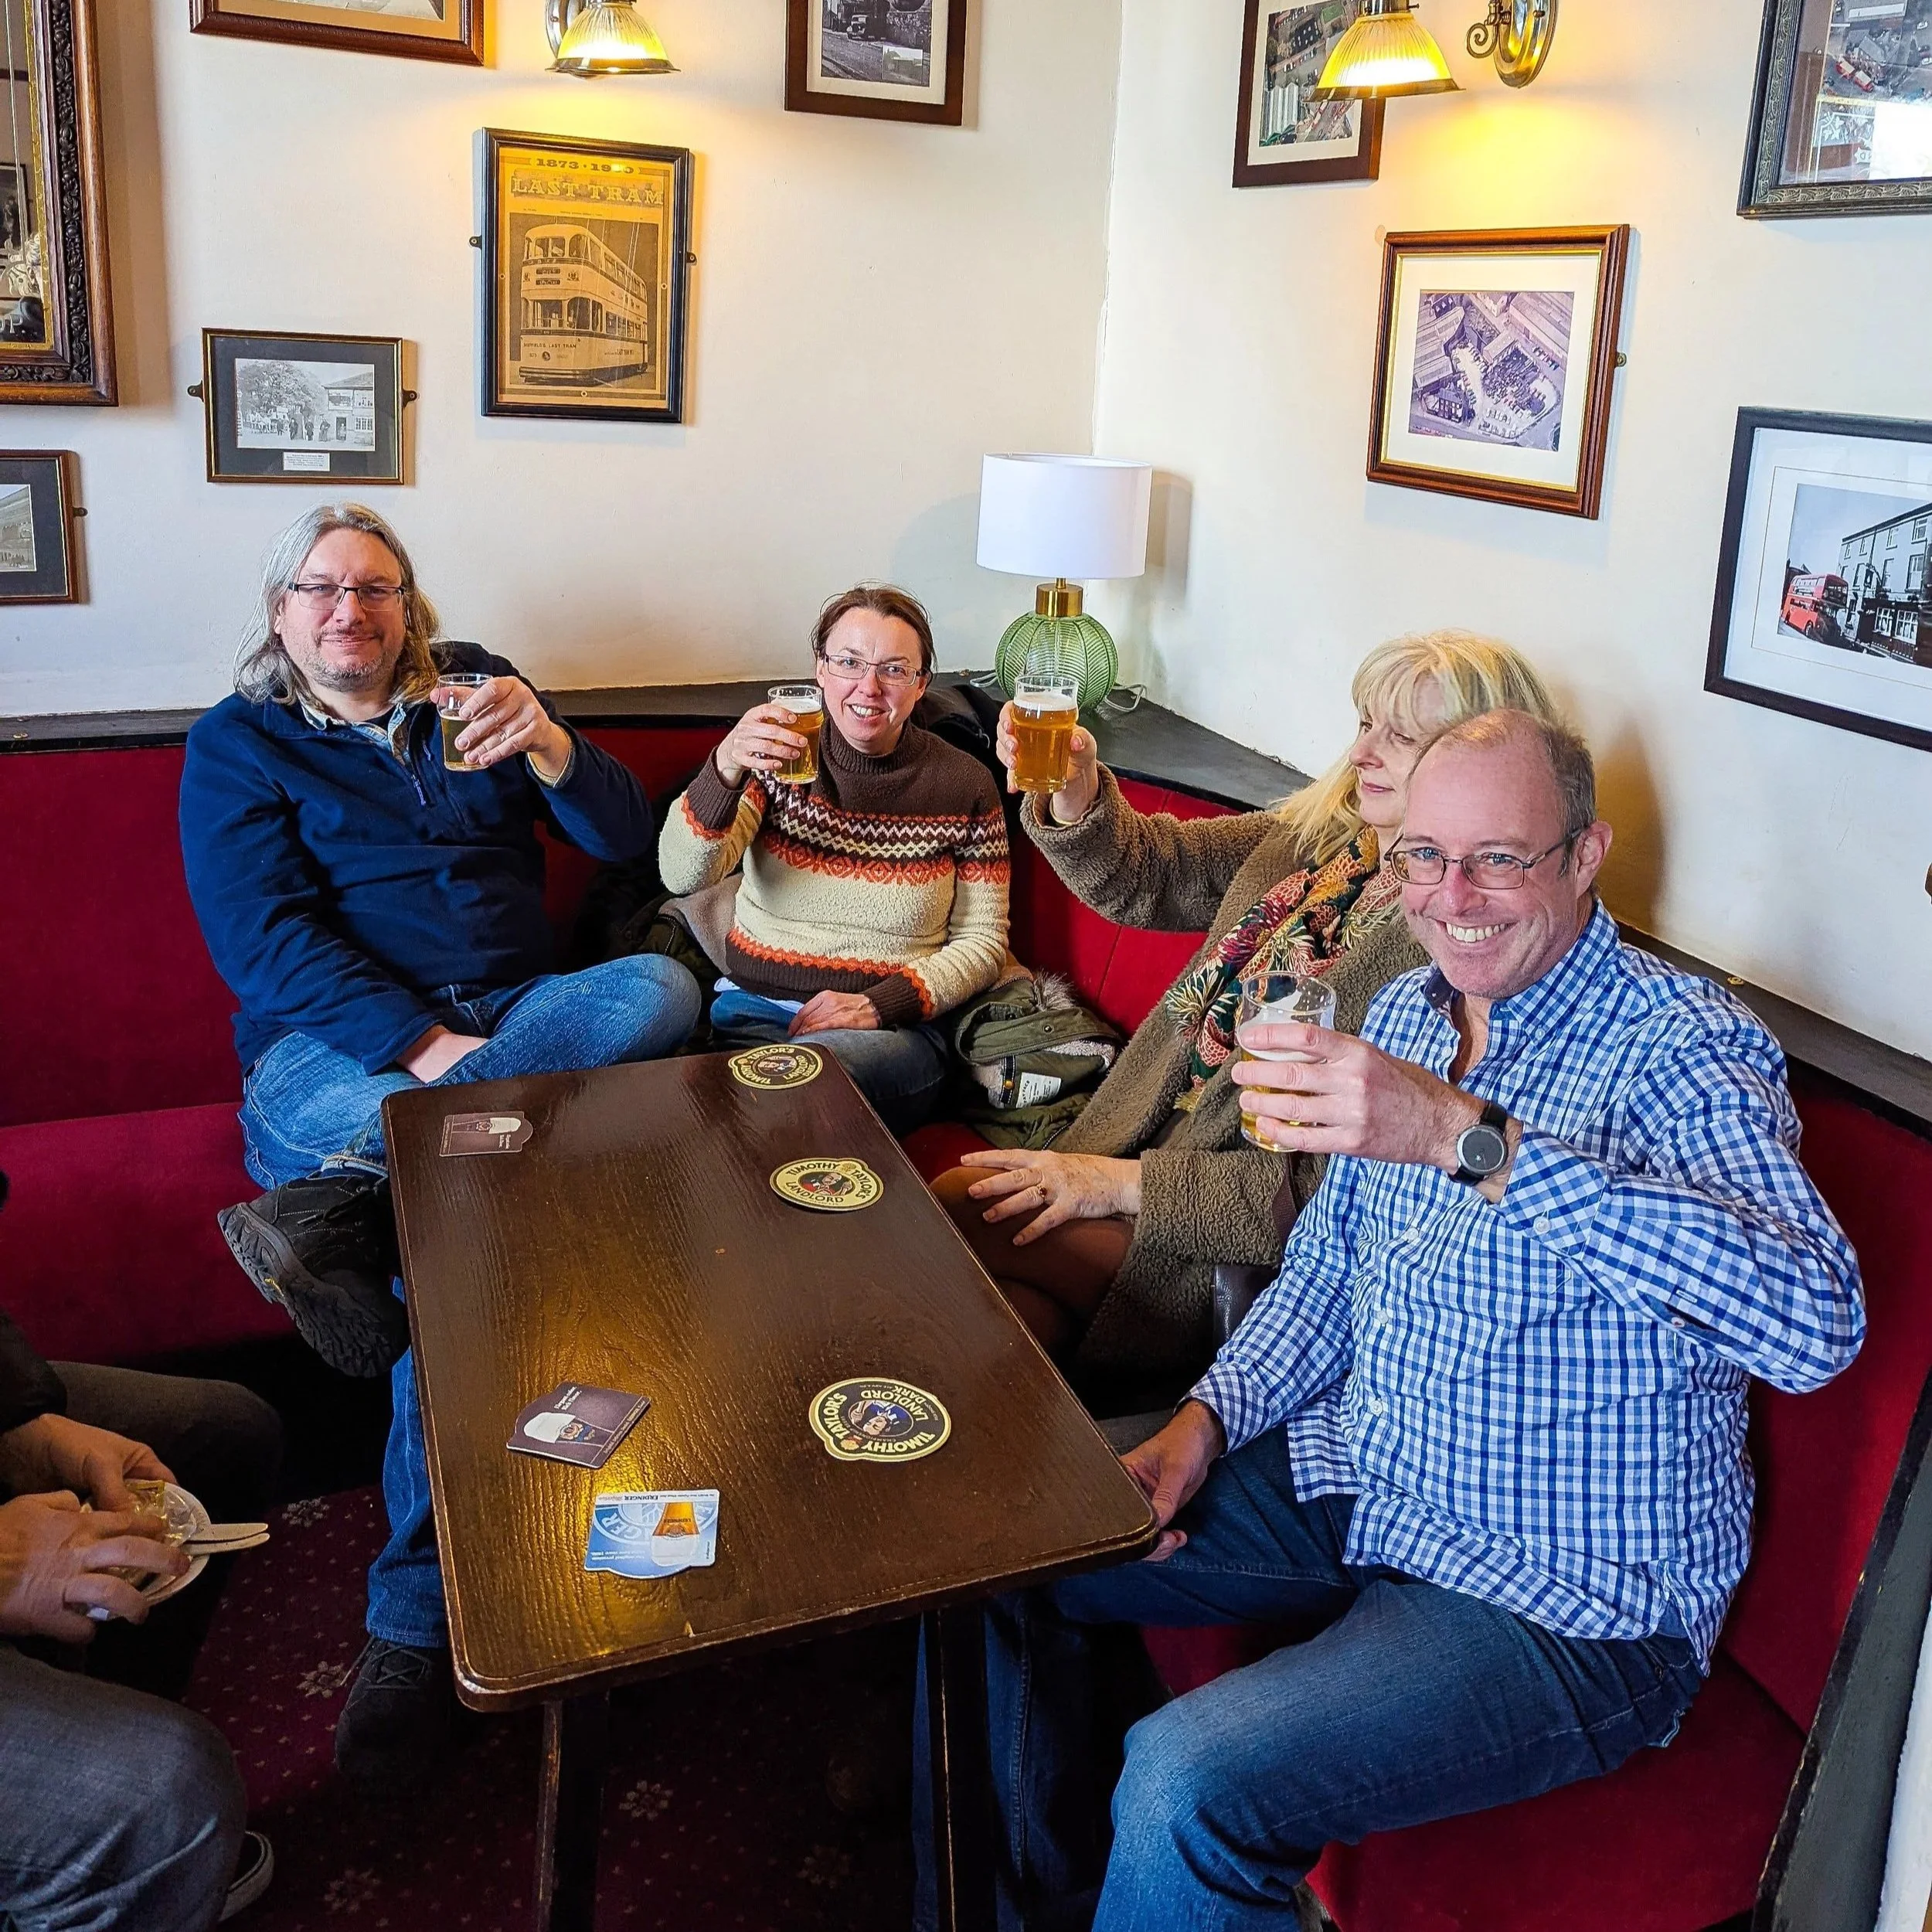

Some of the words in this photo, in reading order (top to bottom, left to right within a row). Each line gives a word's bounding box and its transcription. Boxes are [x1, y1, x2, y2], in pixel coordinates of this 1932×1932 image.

[536, 158, 580, 169] 1873
[590, 163, 634, 174] 190
[512, 177, 580, 198] LAST
[587, 184, 664, 205] TRAM
[740, 1065, 771, 1085] TIMOTHY
[786, 1162, 841, 1177] TIMOTHY
[851, 1169, 873, 1199] TAYLOR'S
[785, 1181, 845, 1204] LANDLORD
[860, 1389, 929, 1421] LANDLORD
[892, 1386, 927, 1404] DARK
[823, 1393, 850, 1440] TAYLOR'S
[861, 1432, 936, 1453] TIMOTHY
